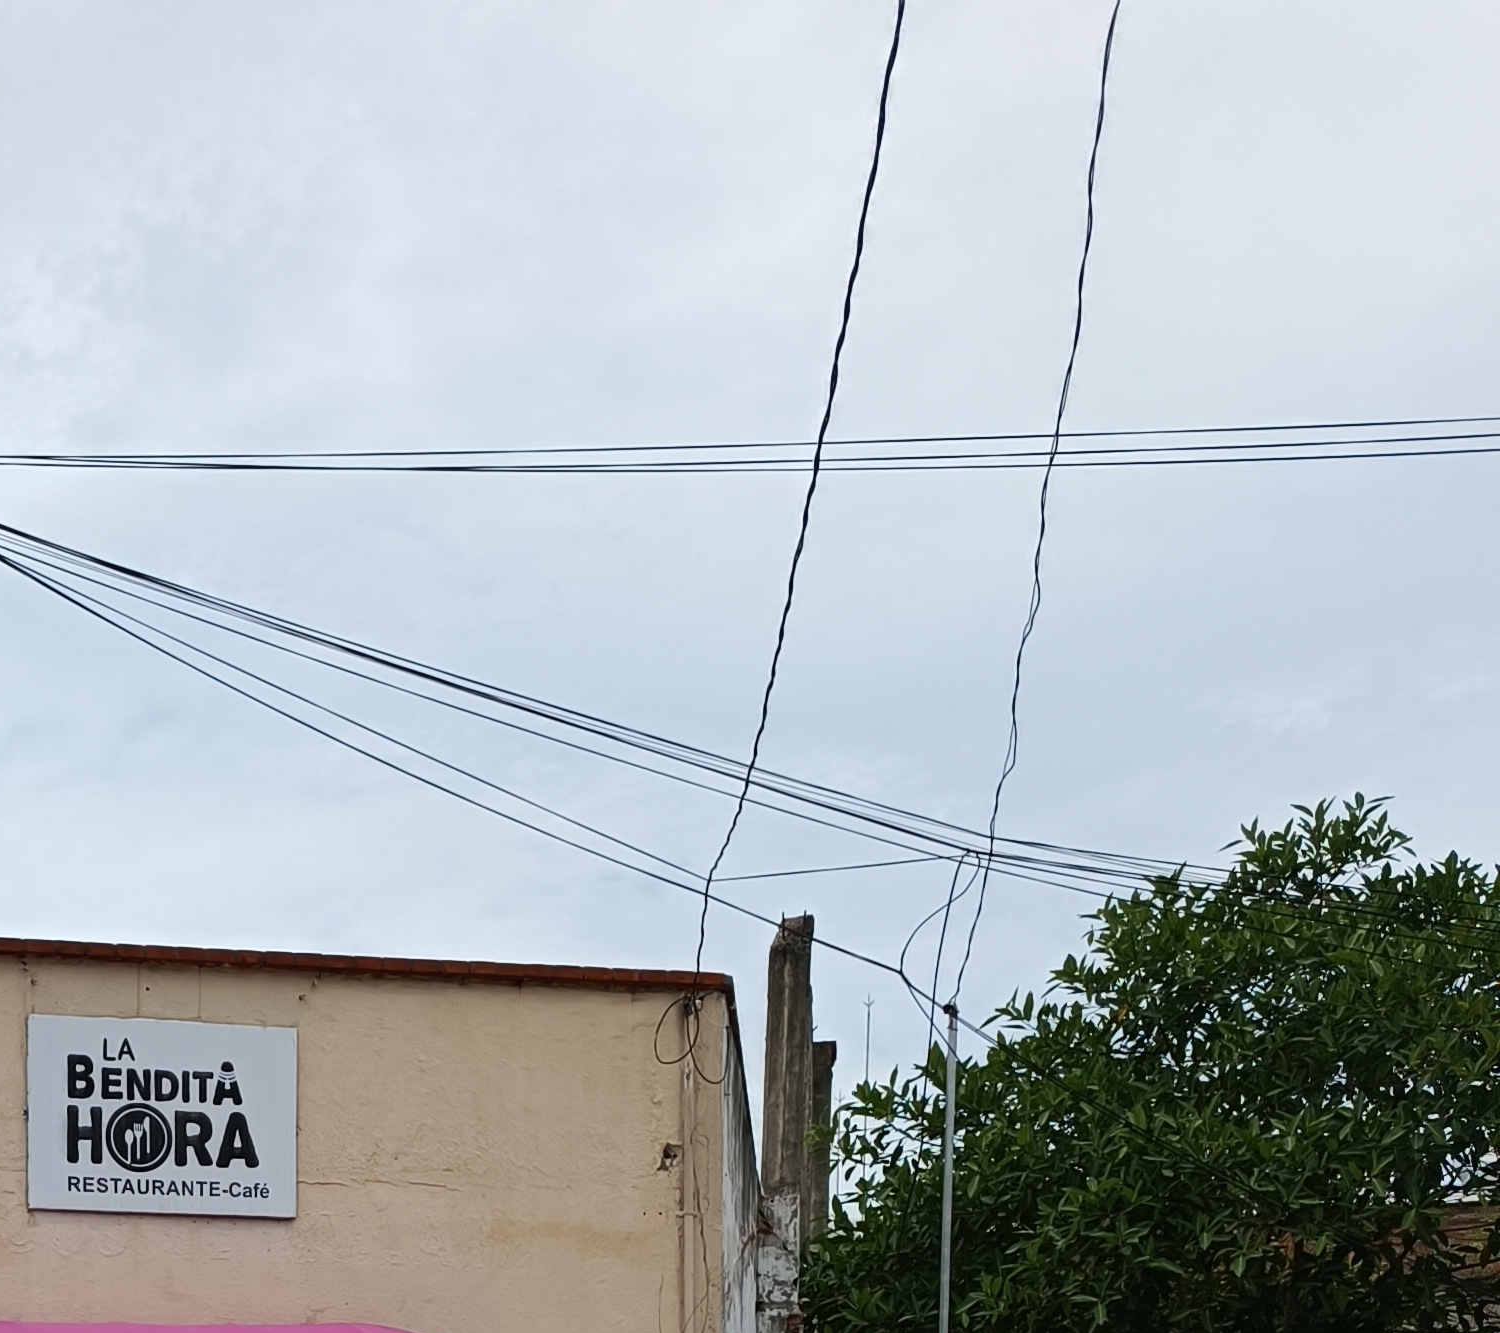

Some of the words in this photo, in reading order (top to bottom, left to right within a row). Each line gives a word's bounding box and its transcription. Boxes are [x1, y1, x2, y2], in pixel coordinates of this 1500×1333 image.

[102, 1037, 135, 1061] LA
[67, 1054, 243, 1105] BENDITA
[66, 1103, 260, 1172] HORA
[67, 1176, 270, 1198] RESTAURANTE-Café
